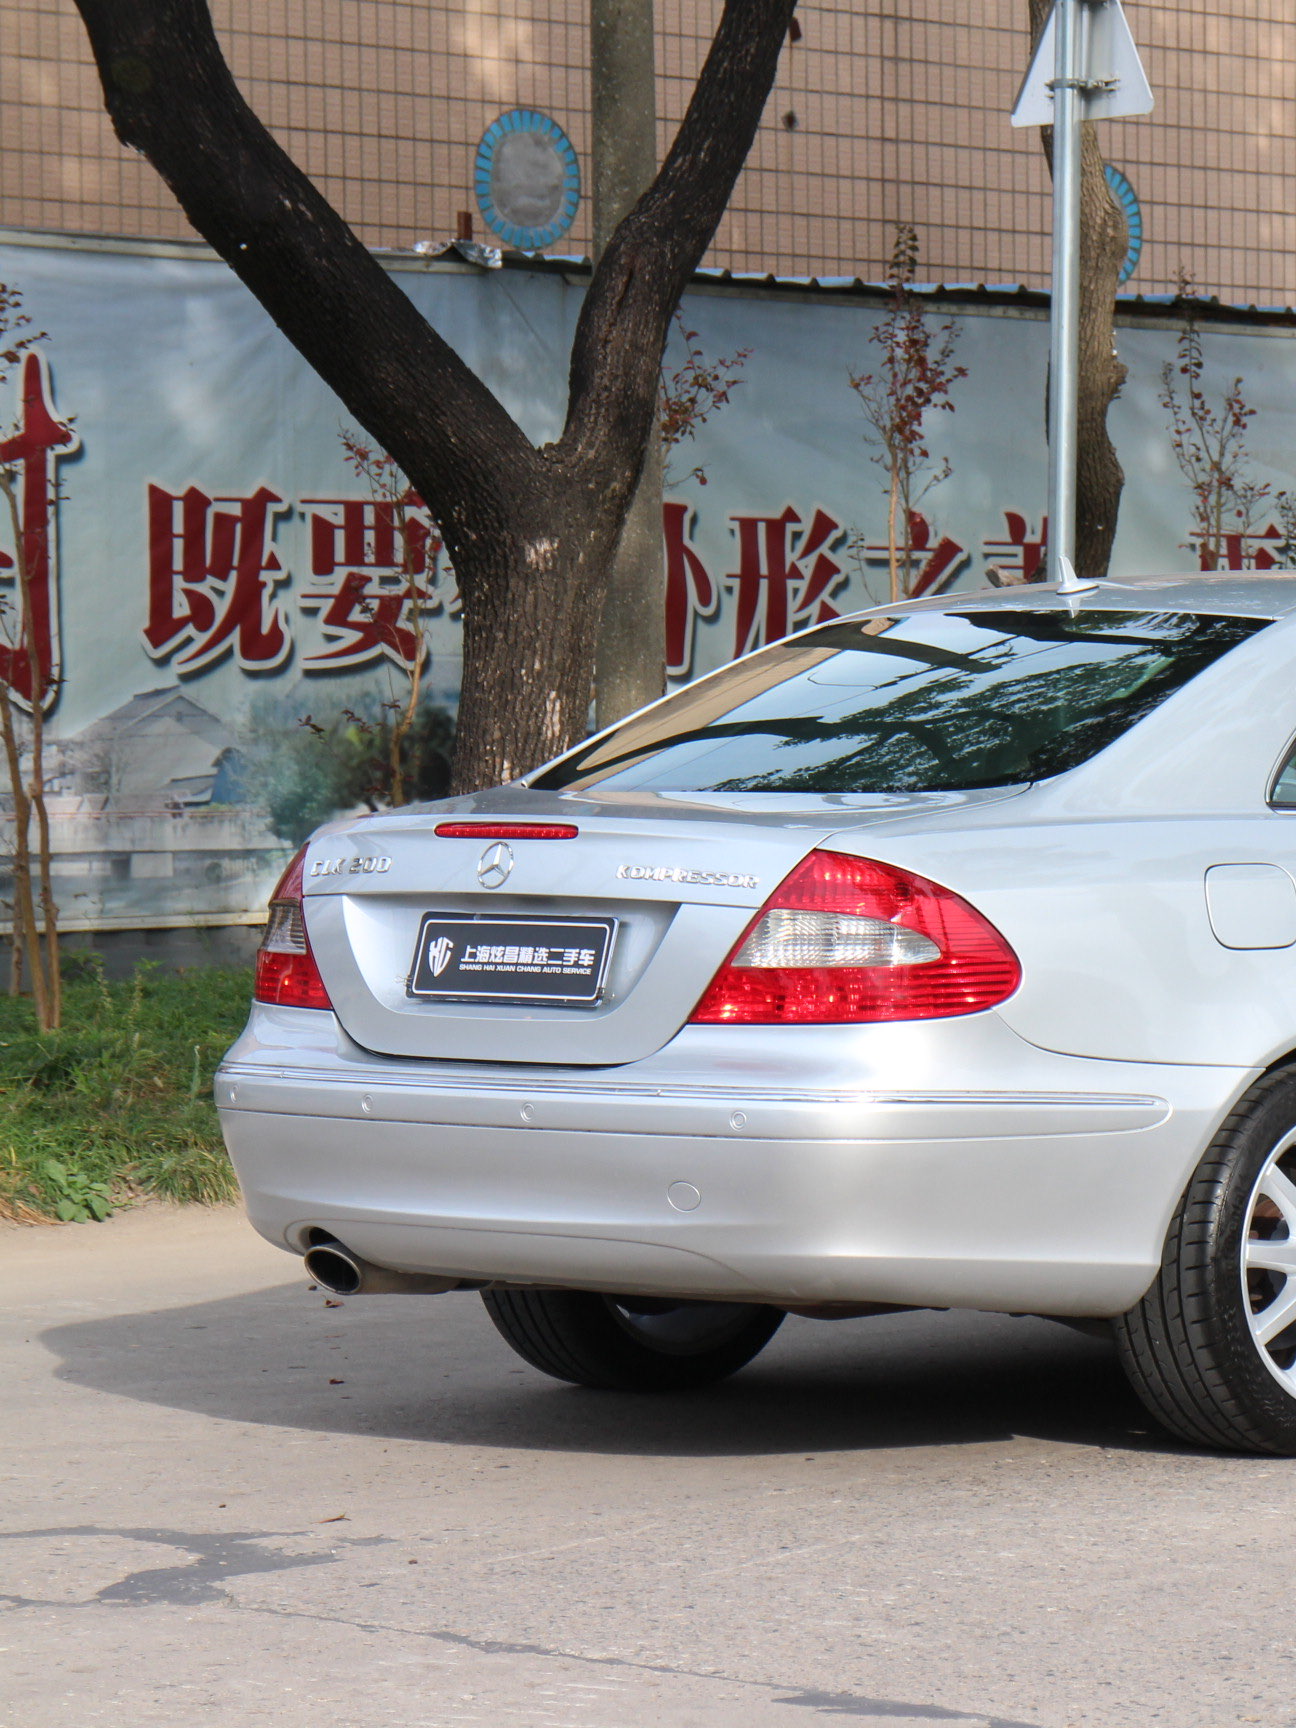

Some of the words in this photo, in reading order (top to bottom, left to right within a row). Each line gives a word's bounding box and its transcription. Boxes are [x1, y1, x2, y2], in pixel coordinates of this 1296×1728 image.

[310, 858, 345, 876] CLK
[349, 856, 392, 874] 200
[615, 863, 760, 889] KOMPRESSOR
[460, 944, 596, 967] 上海炫昌精选二手车
[459, 963, 483, 971] SHANG
[496, 964, 516, 972] XUAN
[516, 965, 541, 973] CHANG
[562, 967, 592, 975] SERVICE
